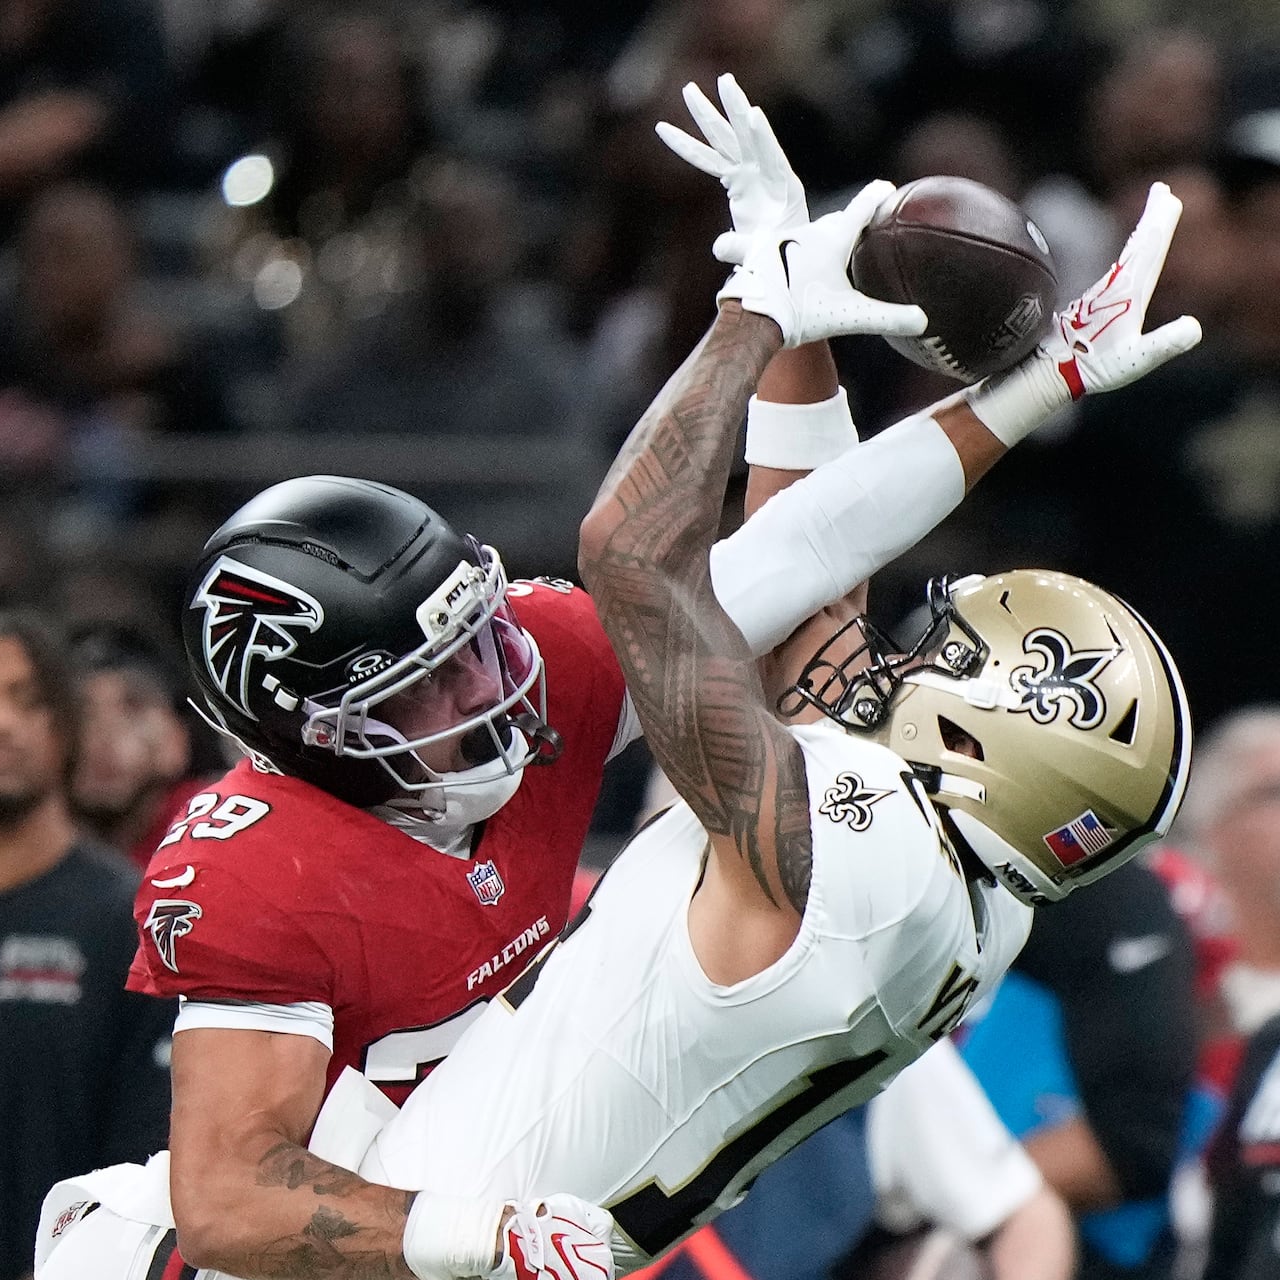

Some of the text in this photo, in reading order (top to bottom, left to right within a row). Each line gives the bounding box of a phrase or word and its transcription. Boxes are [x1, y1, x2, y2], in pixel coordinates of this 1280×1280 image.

[445, 581, 469, 607] ATL
[350, 660, 392, 682] OAKLEY
[157, 793, 270, 851] 29
[467, 915, 550, 991] FALCONS
